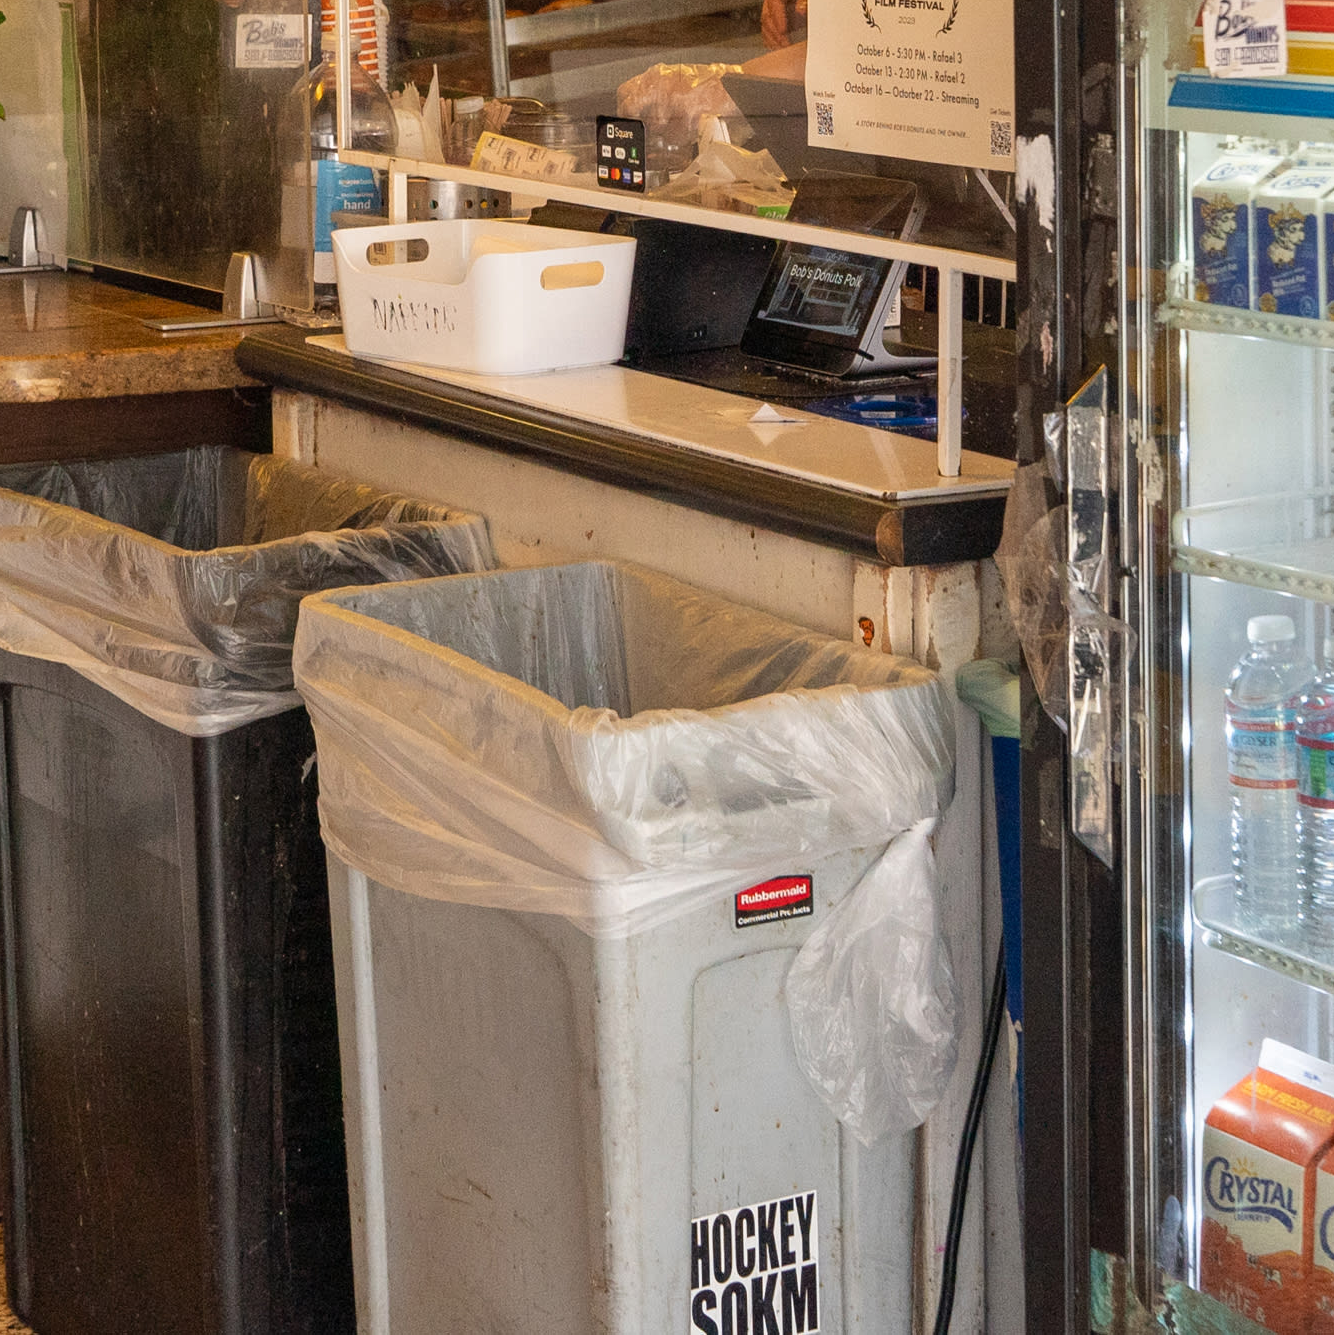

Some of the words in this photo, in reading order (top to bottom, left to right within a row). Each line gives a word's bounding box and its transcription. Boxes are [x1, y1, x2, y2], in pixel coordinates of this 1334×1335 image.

[898, 0, 944, 11] FESTIVAL
[857, 44, 884, 57] October
[885, 46, 890, 57] 6
[897, 47, 913, 59] 5:30
[915, 49, 925, 61] PM
[933, 50, 955, 63] Rafael
[957, 52, 962, 64] 3
[855, 63, 882, 76] October
[885, 66, 892, 77] 13
[899, 67, 915, 79] 2:30
[917, 69, 927, 80] PM
[935, 70, 958, 83] Rafael
[960, 72, 965, 84] 2
[844, 81, 873, 95] October
[875, 84, 883, 96] 16
[924, 90, 934, 101] 22
[941, 91, 979, 109] Streaming
[615, 127, 634, 139] Square
[343, 200, 371, 210] hand
[790, 264, 813, 279] Bob's
[813, 268, 844, 285] Donuts
[741, 883, 807, 905] Rubbermaid
[738, 911, 779, 926] Commercial
[1204, 1155, 1297, 1233] CRYSTAL
[691, 1193, 815, 1291] HOCKEY
